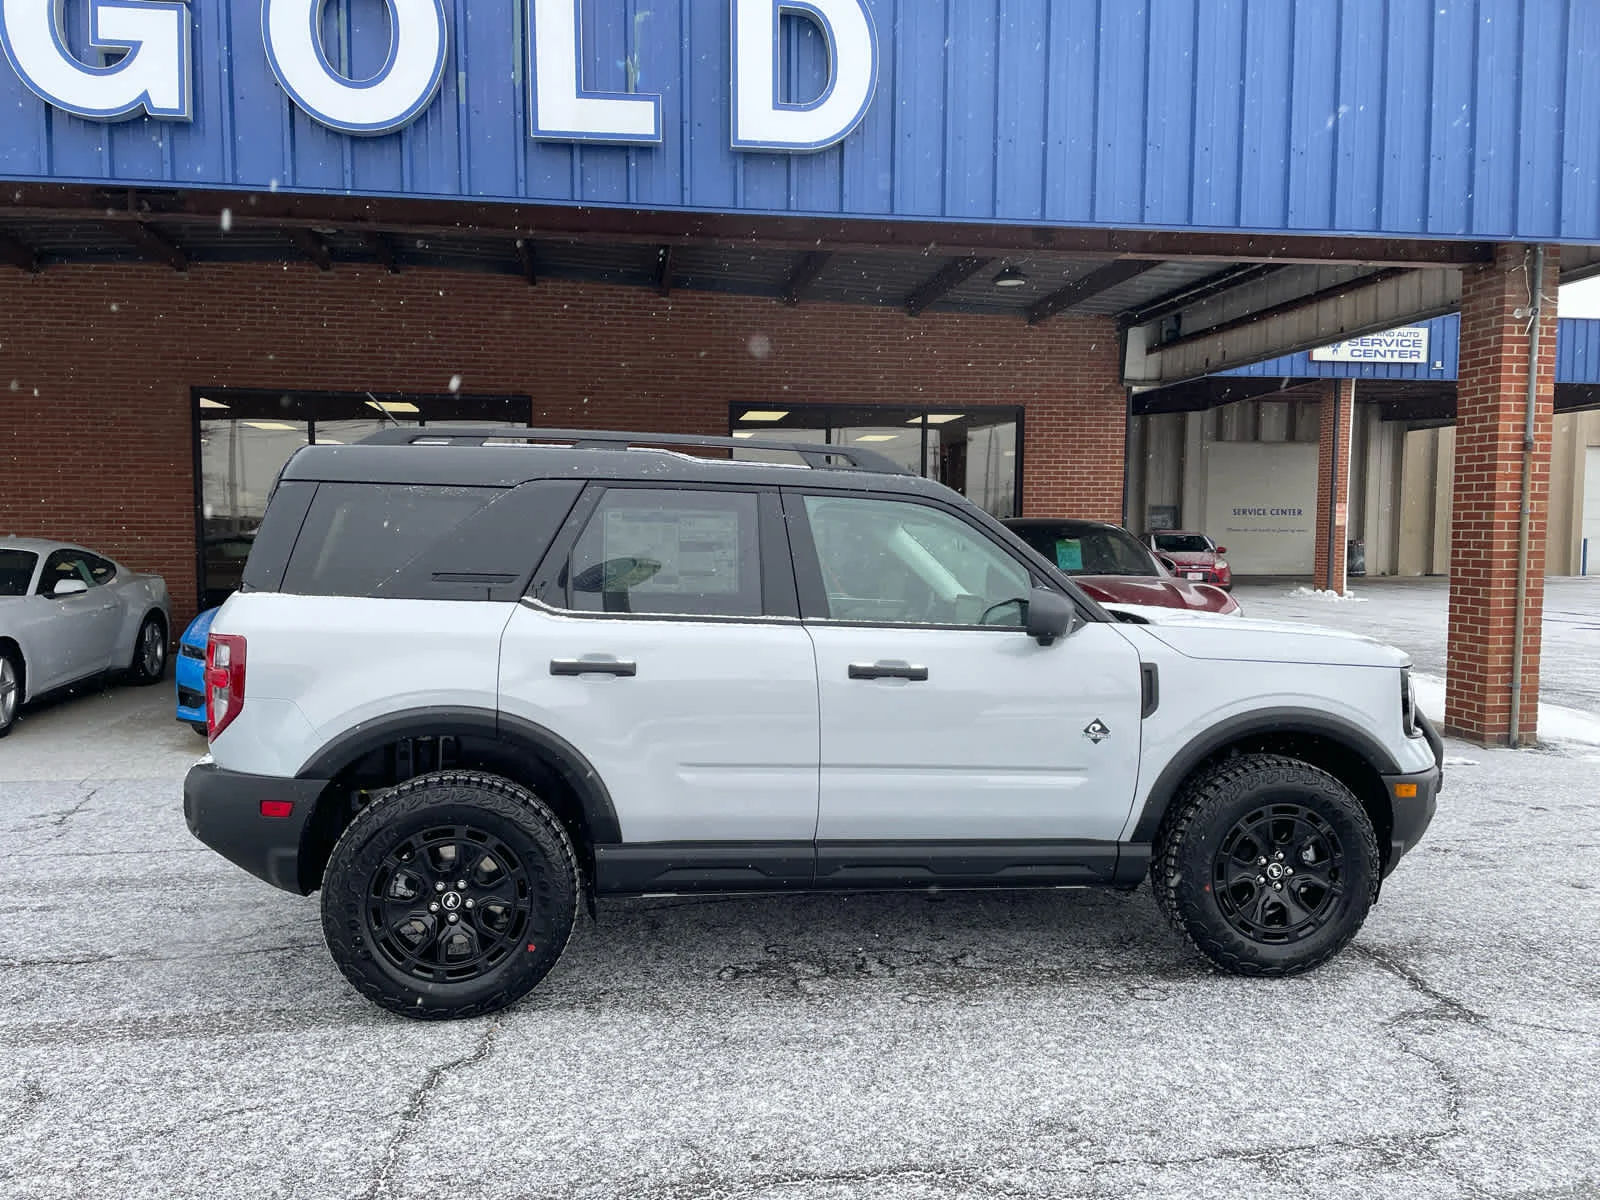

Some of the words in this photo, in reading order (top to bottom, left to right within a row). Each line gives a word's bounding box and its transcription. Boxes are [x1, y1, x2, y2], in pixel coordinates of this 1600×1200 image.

[0, 0, 880, 153] GOLD
[1347, 337, 1423, 348] SERVICE
[1349, 348, 1421, 359] CENTER
[1232, 508, 1267, 516] SERVICE
[1270, 508, 1303, 516] CENTER
